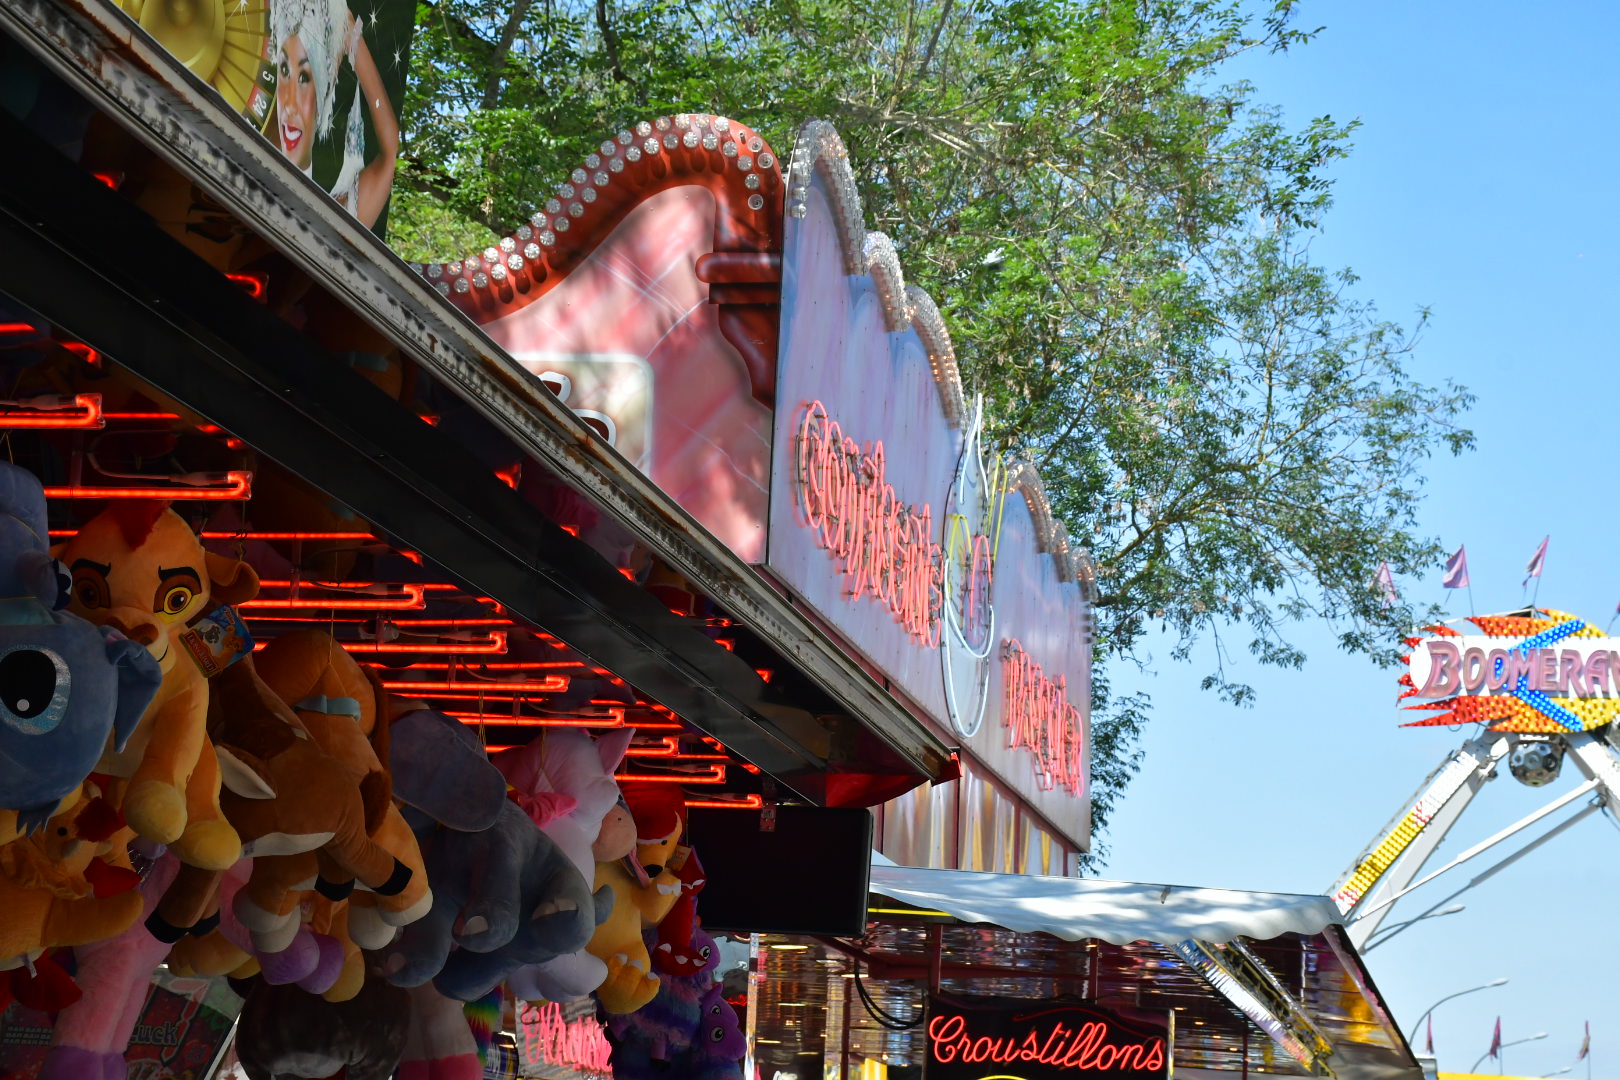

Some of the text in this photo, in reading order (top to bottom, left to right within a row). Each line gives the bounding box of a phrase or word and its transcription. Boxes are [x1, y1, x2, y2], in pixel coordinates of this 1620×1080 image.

[262, 70, 275, 84] 5
[252, 93, 267, 118] 24
[928, 1015, 1164, 1071] Croustillons
